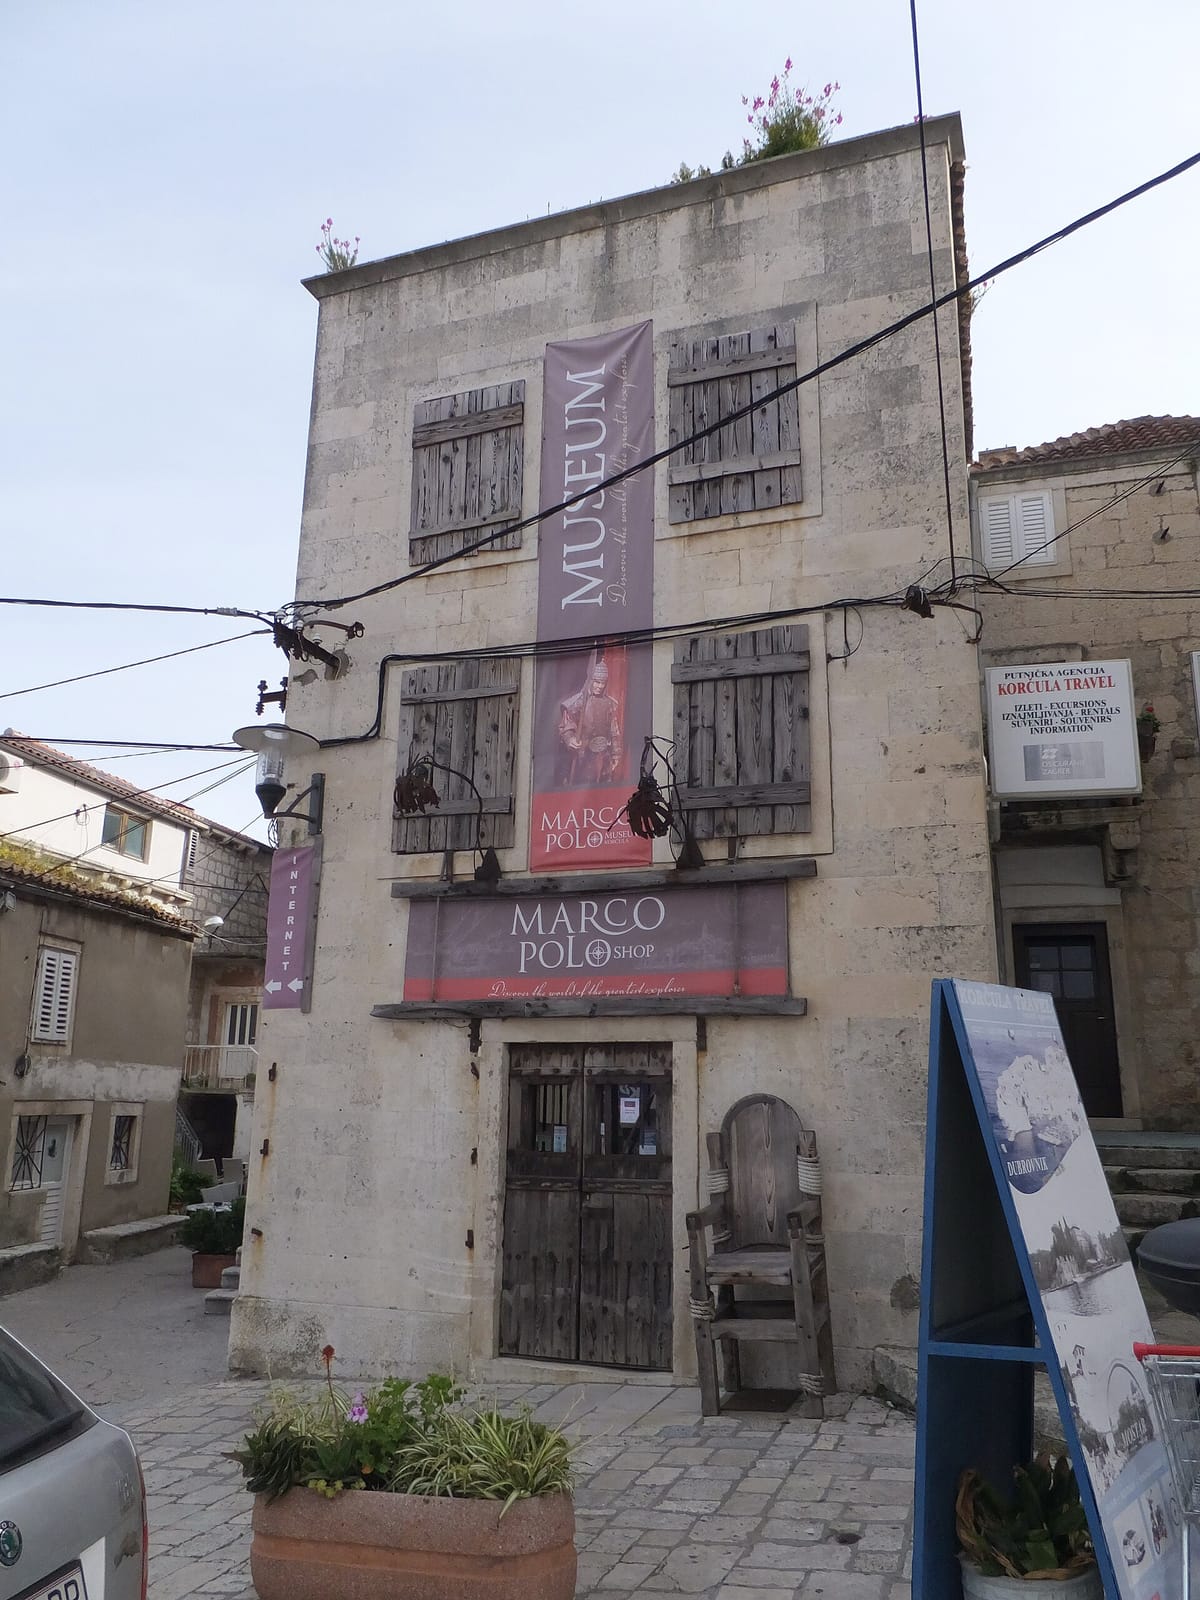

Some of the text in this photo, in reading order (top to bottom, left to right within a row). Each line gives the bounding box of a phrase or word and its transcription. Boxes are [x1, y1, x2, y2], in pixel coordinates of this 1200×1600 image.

[561, 363, 607, 610] MUSEUM
[608, 490, 628, 523] world
[608, 528, 628, 546] the
[606, 549, 628, 607] Discover
[1056, 667, 1105, 677] AGENCIJA
[997, 675, 1116, 696] KORČULA TRAVEL
[1001, 709, 1074, 720] IZNAJMLJIVANJA
[1081, 706, 1121, 716] RENTALS
[1014, 703, 1043, 712] IZLETI
[1050, 699, 1107, 710] EXCURSIONS
[1011, 718, 1053, 728] SUVENIRI
[1060, 715, 1112, 725] SOUVENIRS
[1030, 724, 1094, 735] INFORMATION
[545, 828, 637, 852] POLO MUSEU
[282, 856, 298, 971] INTERNET
[510, 896, 666, 936] MARCO
[518, 935, 655, 973] POLO SHOP
[487, 980, 530, 997] Discover
[532, 981, 547, 997] the
[548, 980, 576, 997] world
[588, 979, 604, 996] the
[605, 980, 643, 997] greatest
[643, 977, 686, 996] explorer
[1007, 1156, 1048, 1177] DUBROVNIK
[1121, 1417, 1147, 1447] MOSTAR
